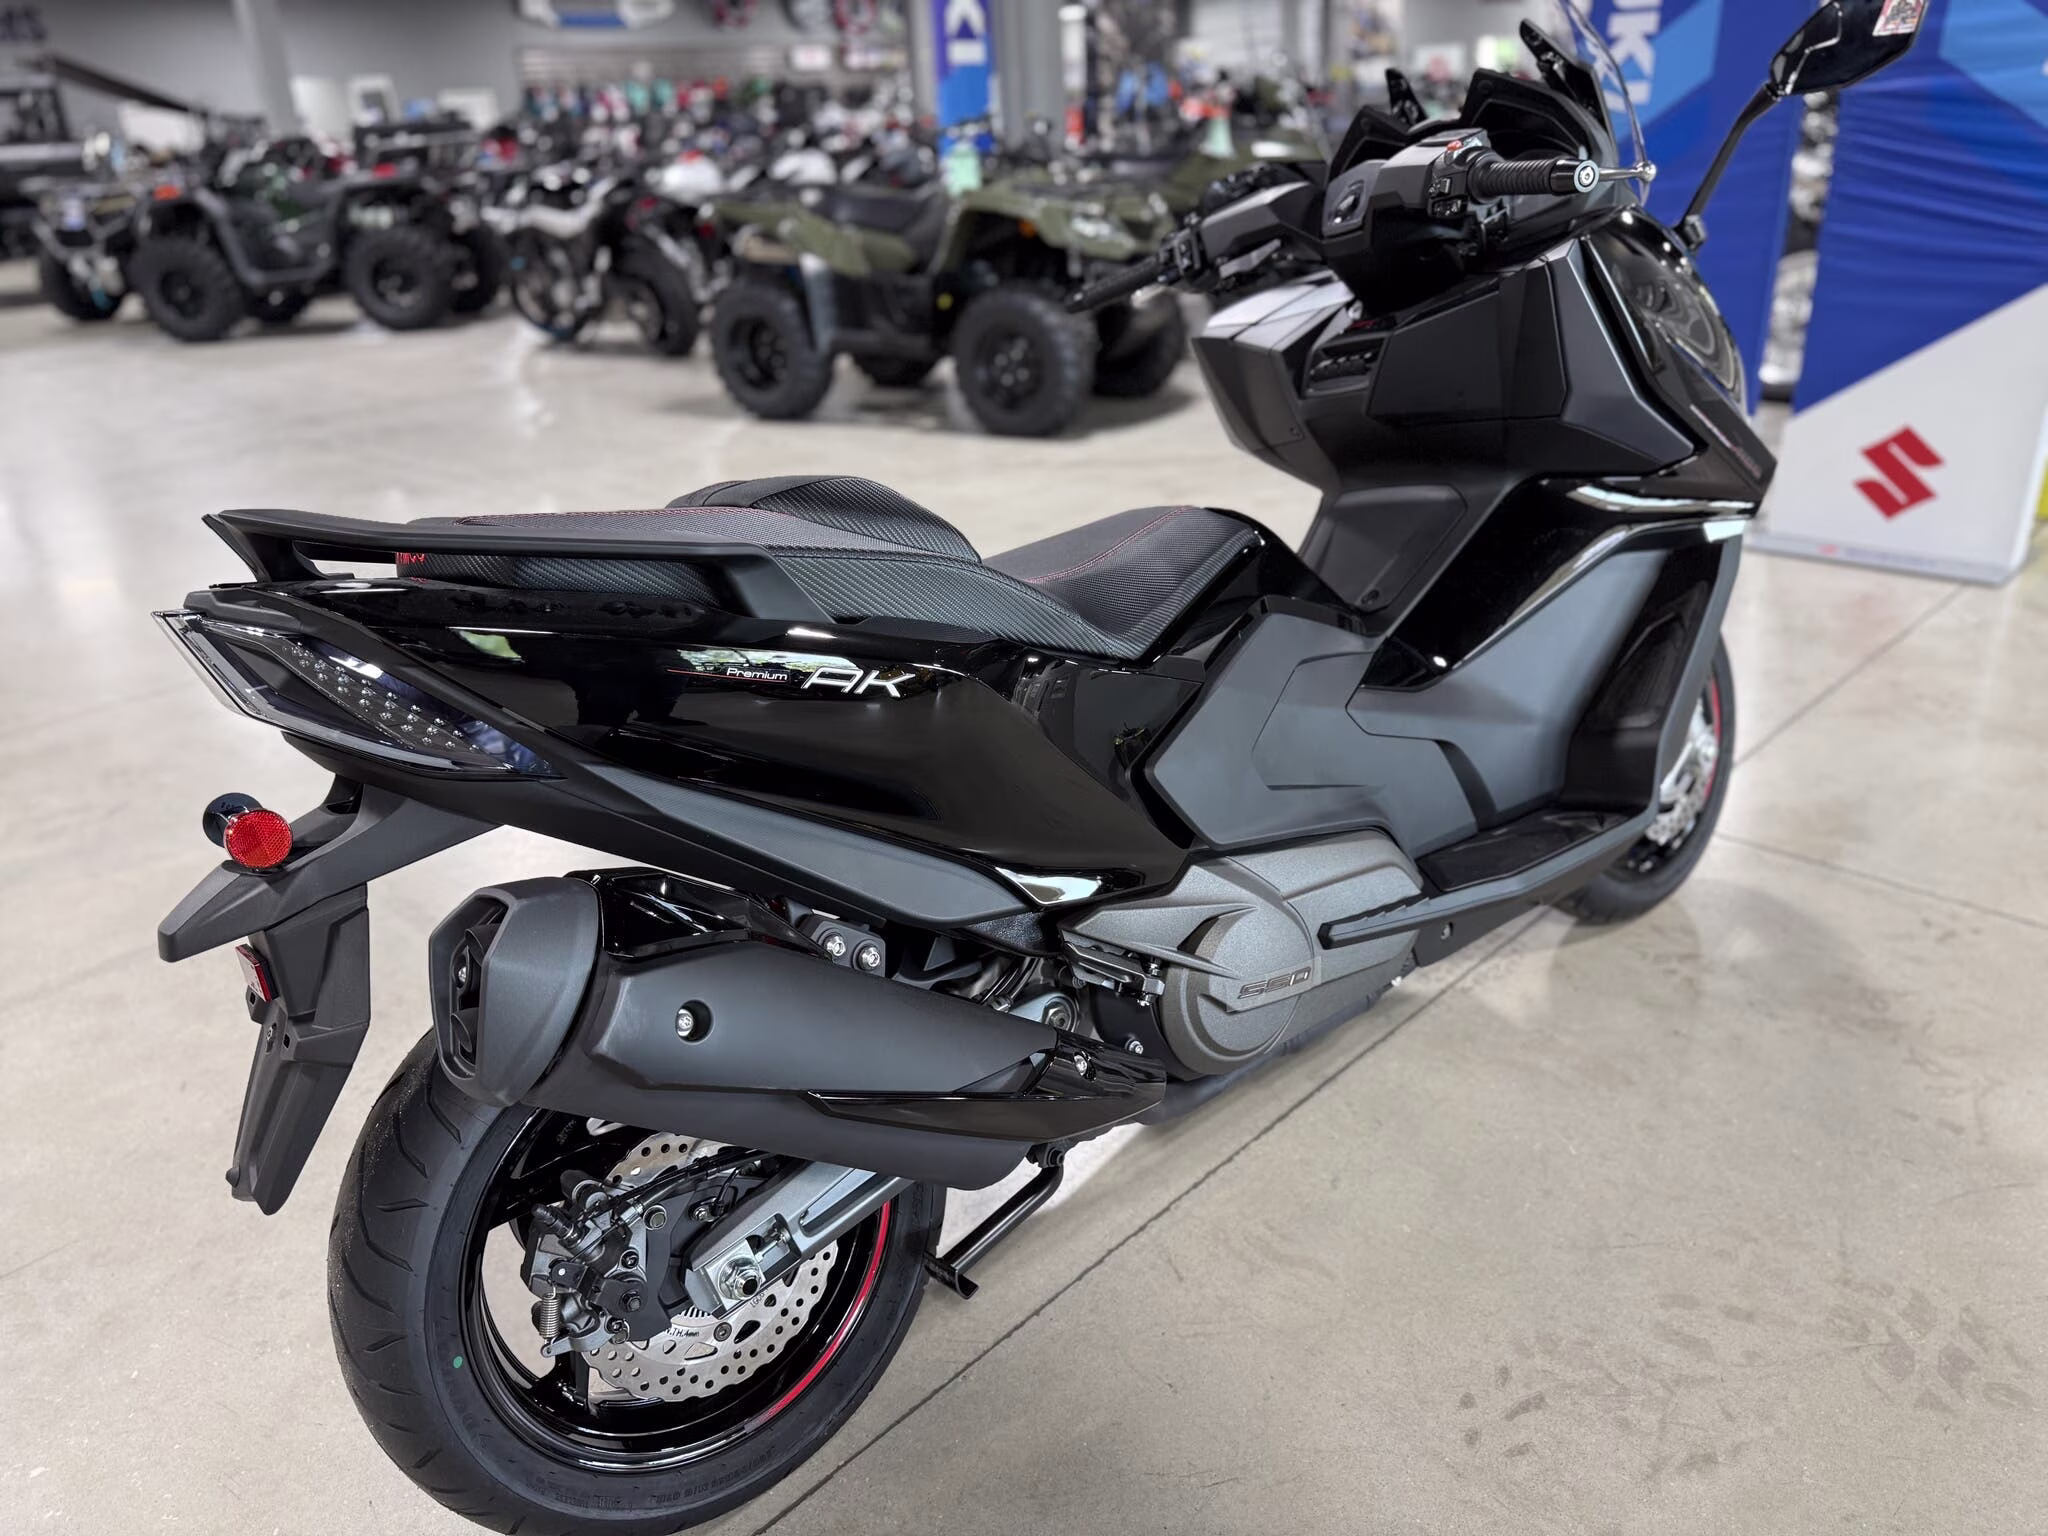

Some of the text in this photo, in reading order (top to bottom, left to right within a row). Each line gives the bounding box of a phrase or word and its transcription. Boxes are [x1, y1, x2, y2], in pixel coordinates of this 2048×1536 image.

[726, 666, 916, 698] Premium AK
[1237, 966, 1311, 999] 550
